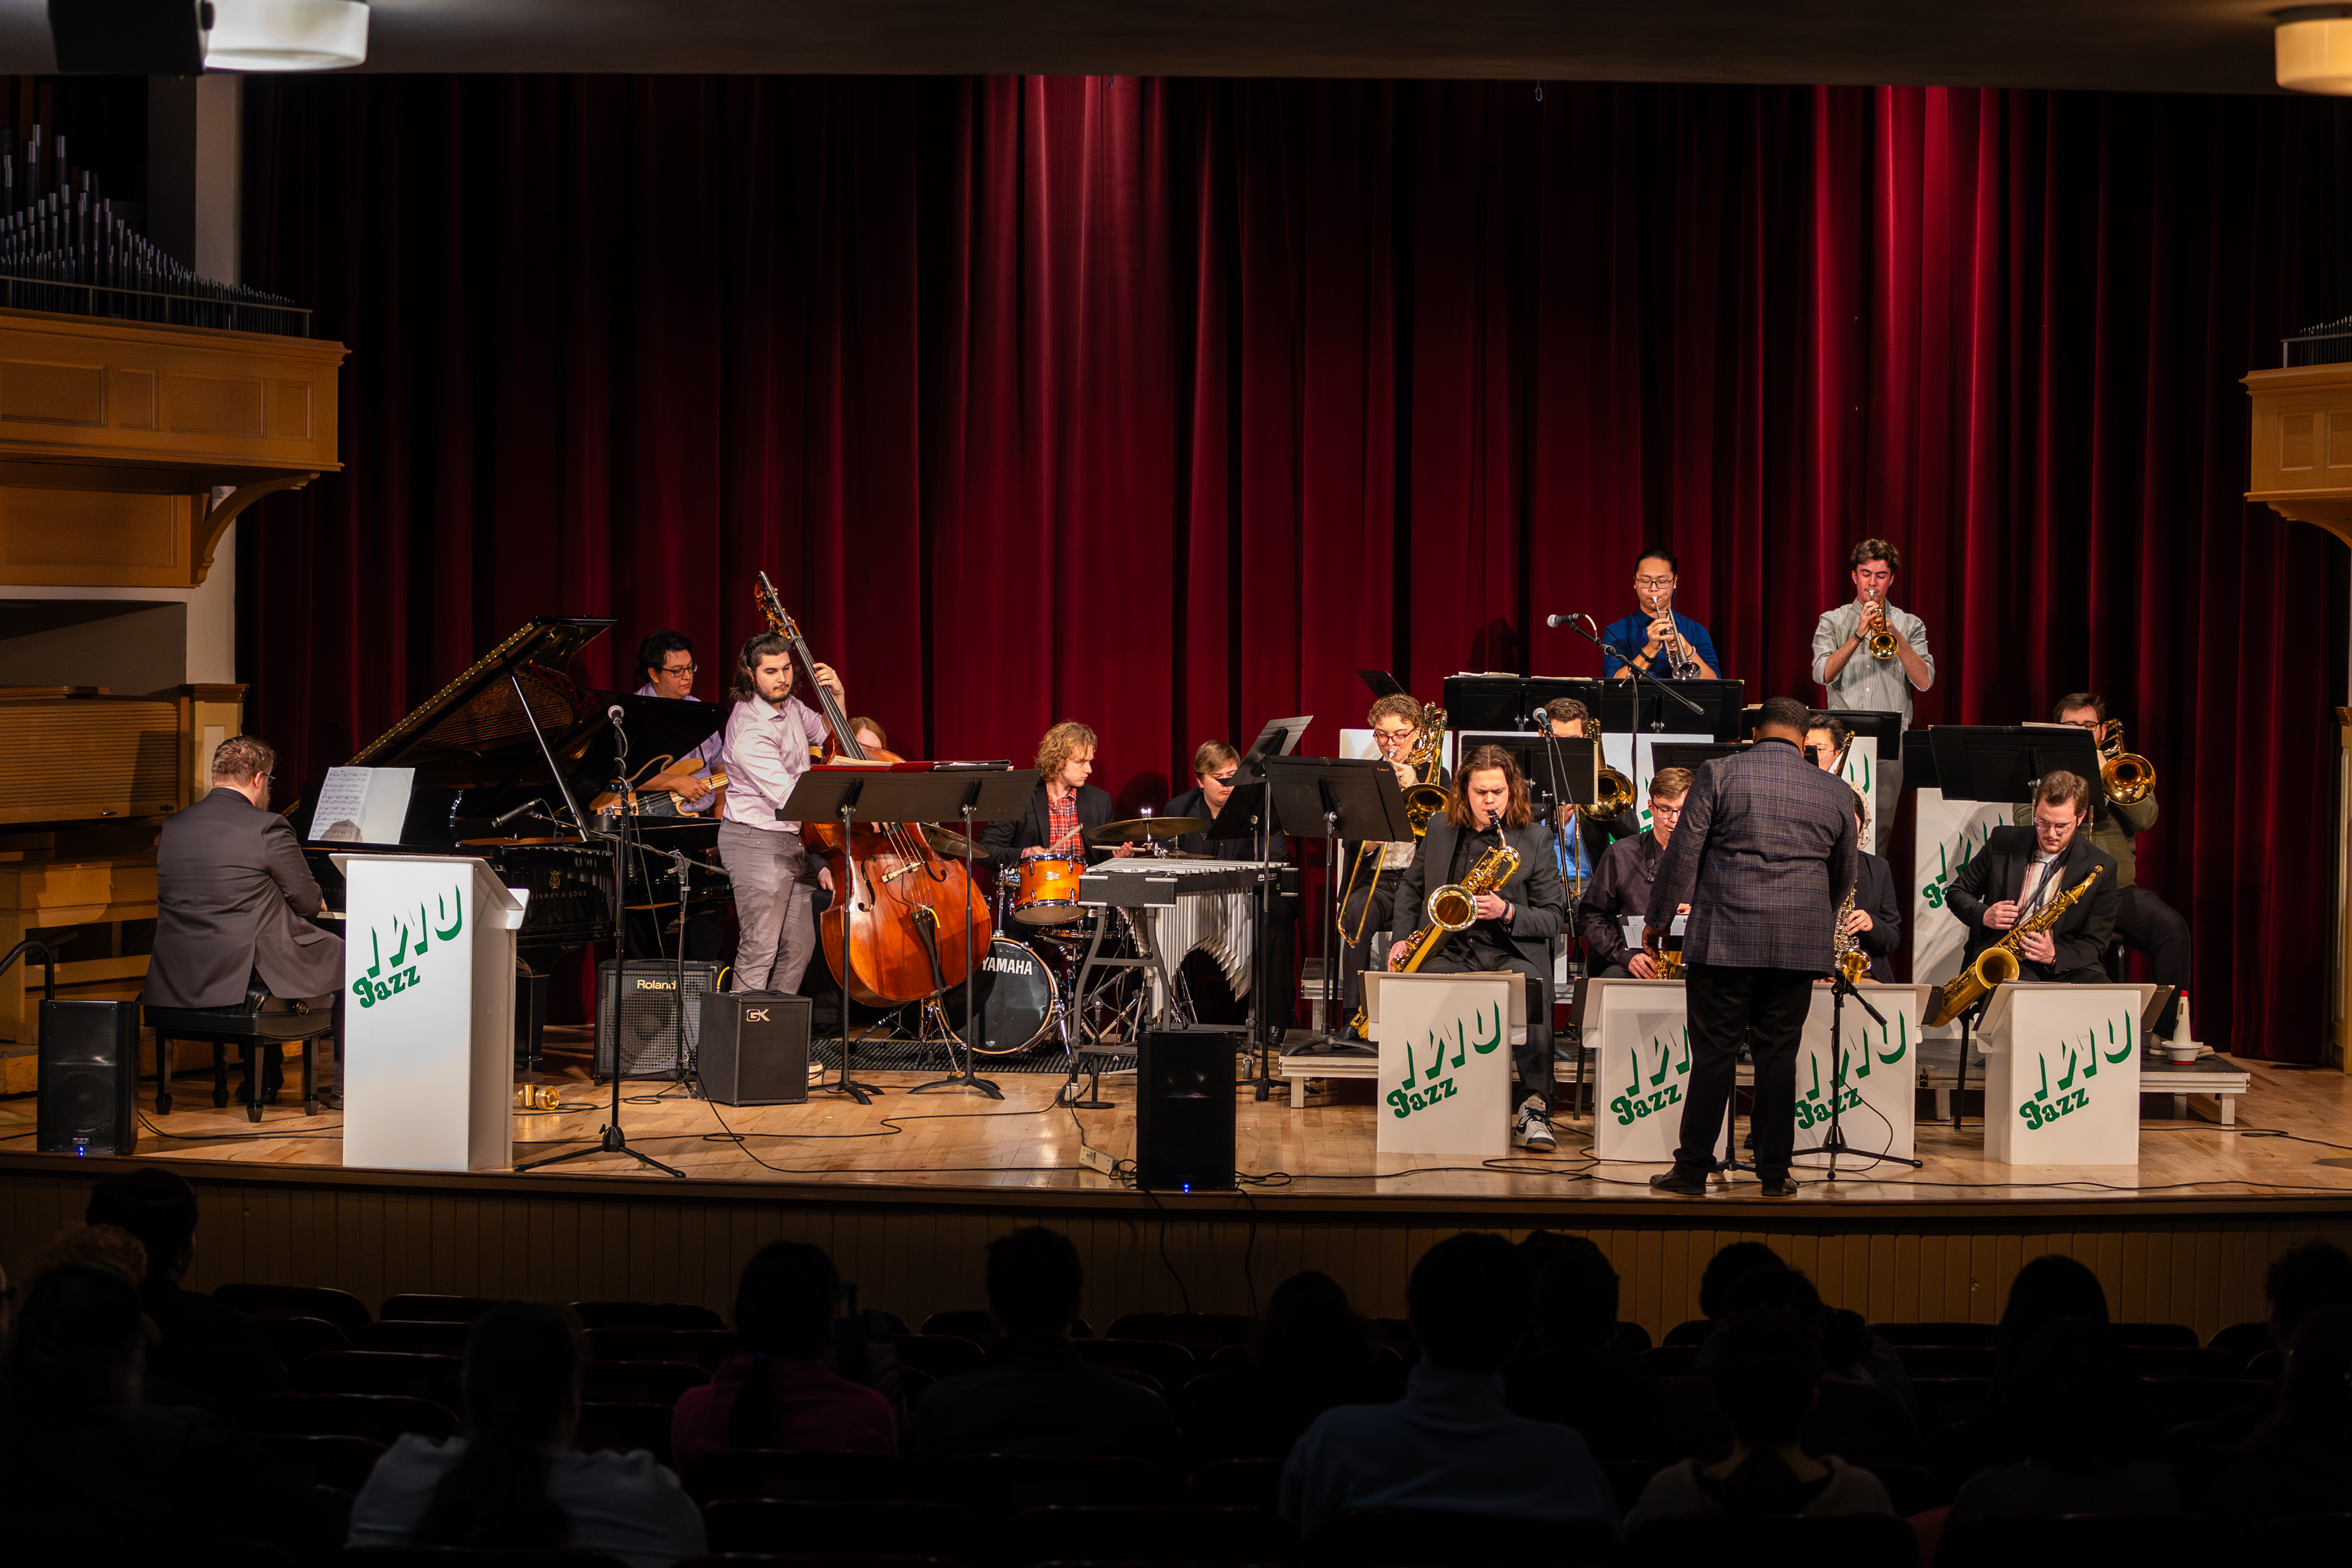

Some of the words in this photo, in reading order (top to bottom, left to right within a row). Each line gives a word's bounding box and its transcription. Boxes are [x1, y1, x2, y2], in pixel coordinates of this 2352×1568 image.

[982, 956, 1032, 976] YAMAHA
[637, 979, 676, 989] Roland
[746, 1009, 771, 1021] GK
[1625, 1022, 1690, 1098] IW
